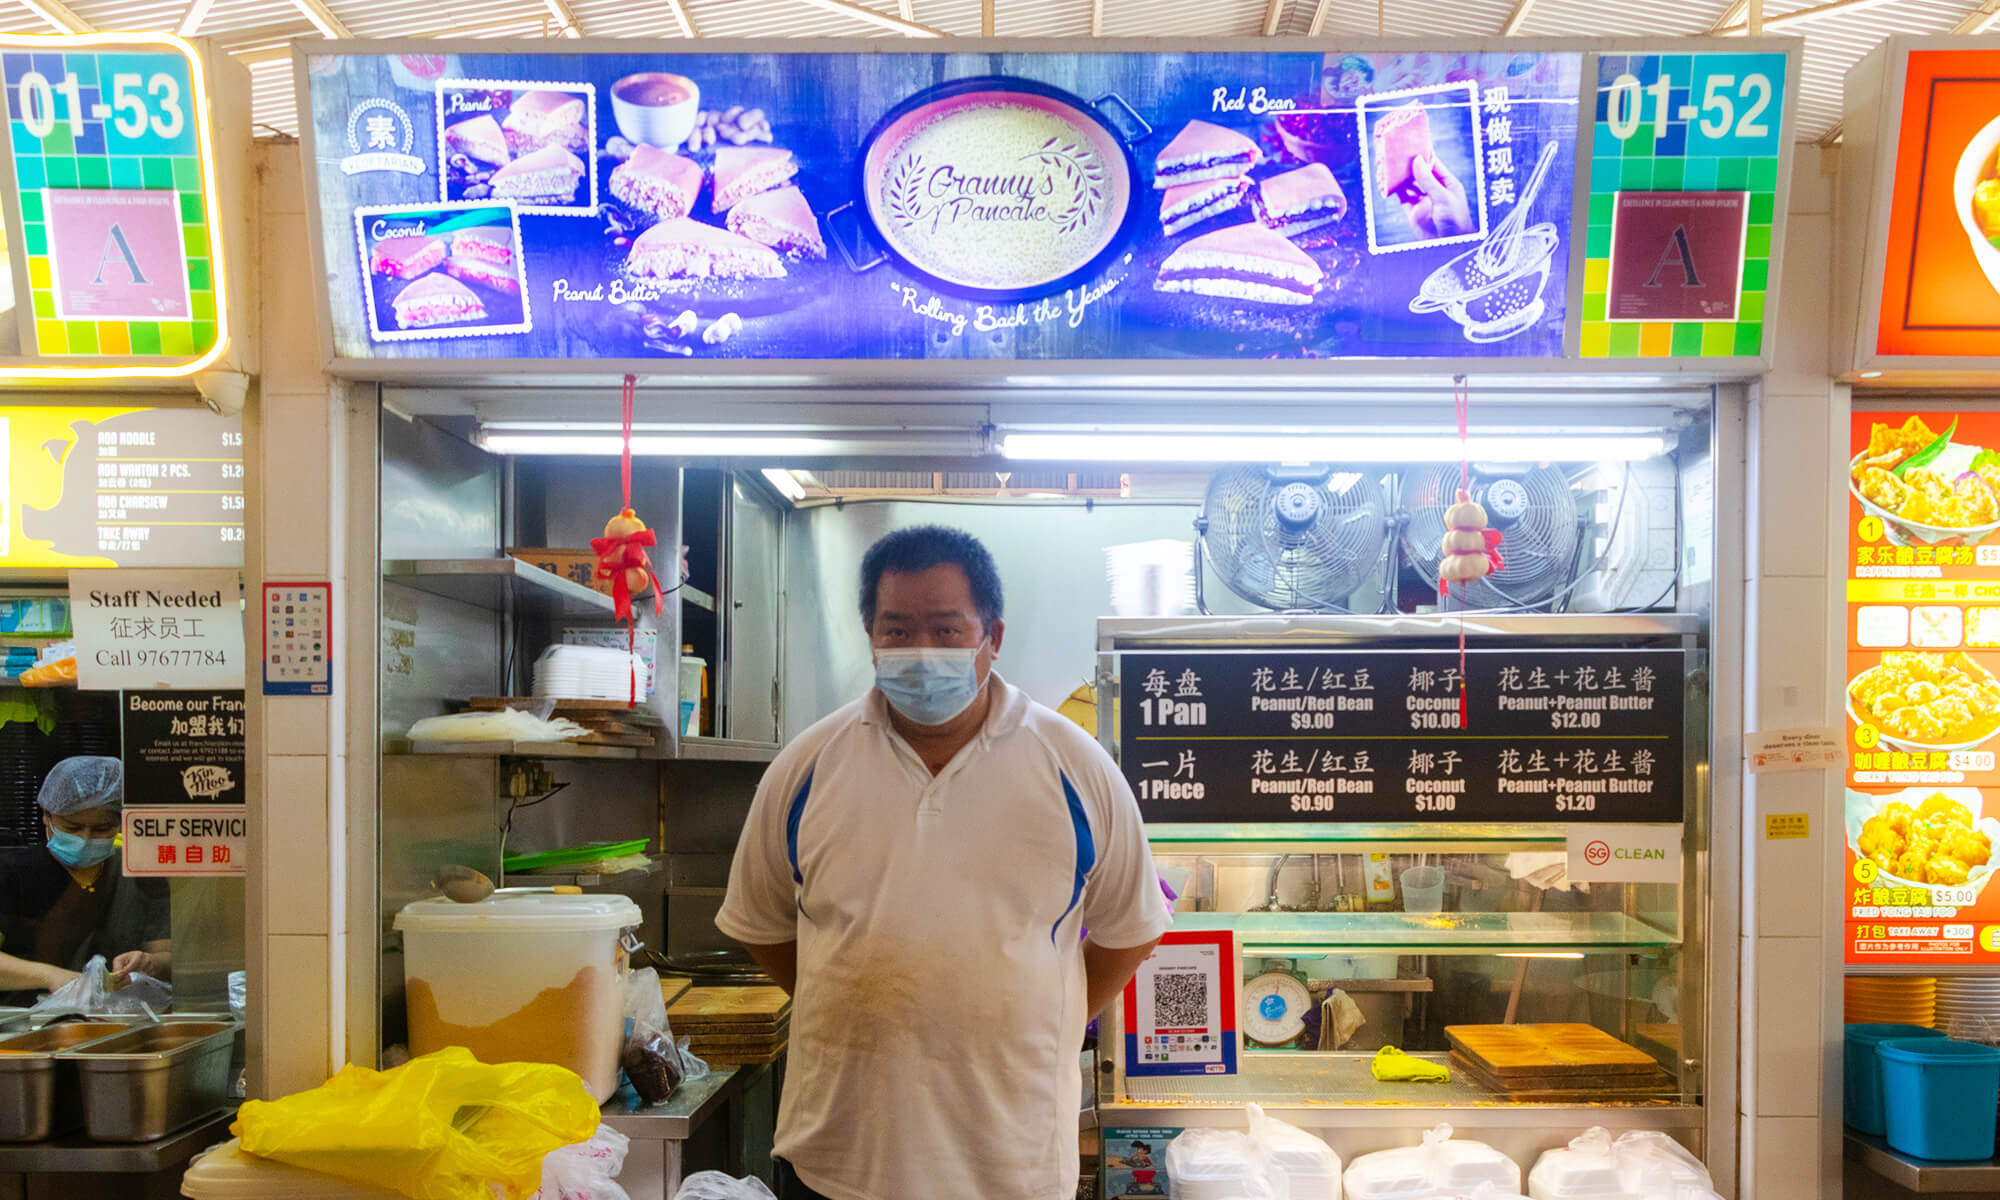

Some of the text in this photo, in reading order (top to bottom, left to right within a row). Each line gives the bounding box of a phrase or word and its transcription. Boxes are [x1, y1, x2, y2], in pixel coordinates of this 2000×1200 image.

[19, 72, 184, 139] 01-53
[450, 93, 494, 113] Peanut
[1212, 87, 1296, 114] Red Bean
[1607, 73, 1771, 139] 01-52
[366, 115, 396, 149] 素
[1485, 86, 1515, 206] 现做现卖
[928, 165, 1054, 202] Granny's
[946, 196, 1050, 224] Pancake
[371, 218, 426, 239] Coconut
[90, 222, 153, 286] A
[1642, 223, 1706, 287] A
[552, 280, 660, 304] Peanut Butter
[973, 305, 1029, 331] Back
[1032, 299, 1062, 323] the
[222, 432, 243, 447] $1.5
[161, 464, 167, 477] 2
[170, 464, 191, 478] PCS.
[222, 464, 244, 478] $1.2
[220, 528, 244, 542] $0.2
[1866, 522, 1874, 537] 1
[1982, 549, 2000, 561] $5
[89, 590, 222, 608] Staff Needed
[1974, 586, 2000, 597] CHO
[110, 617, 205, 640] 征求员工
[96, 650, 226, 667] Call 97677784
[1141, 668, 1203, 697] 每盘
[1251, 667, 1375, 692] 花生/红豆
[1408, 666, 1463, 693] 椰子
[1497, 666, 1656, 693] 花生+花生酱
[130, 695, 245, 711] Become our Fran
[1139, 698, 1207, 725] 1 Pan
[1251, 696, 1374, 711] Peanut/Red Bean
[1406, 695, 1462, 711] Coconu
[1498, 695, 1654, 711] Peanut+Peanut Butter
[170, 714, 244, 736] 加盟我们
[1291, 712, 1333, 730] $9.00
[1411, 712, 1461, 729] $10.00
[1551, 712, 1601, 729] $12.00
[1864, 728, 1871, 743] 3
[1141, 749, 1197, 779] 一片
[1251, 749, 1374, 774] 花生/红豆
[1408, 748, 1463, 776] 椰子
[1497, 748, 1656, 776] 花生+花生酱
[1954, 755, 1992, 767] $4.00
[1139, 780, 1205, 800] 1 Piece
[1251, 778, 1374, 794] Peanut/Red Bean
[1406, 778, 1465, 793] Coconut
[1498, 778, 1654, 793] Peanut+Peanut Butter
[1291, 795, 1333, 812] $0.90
[1415, 794, 1456, 812] $1.00
[1556, 794, 1596, 812] $1.20
[133, 818, 175, 837] SELF
[158, 845, 230, 864] 請自助
[1588, 847, 1665, 860] SG CLEAN
[1861, 864, 1870, 878] 5
[1936, 890, 1973, 902] $5.00
[1857, 925, 1886, 939] 打包
